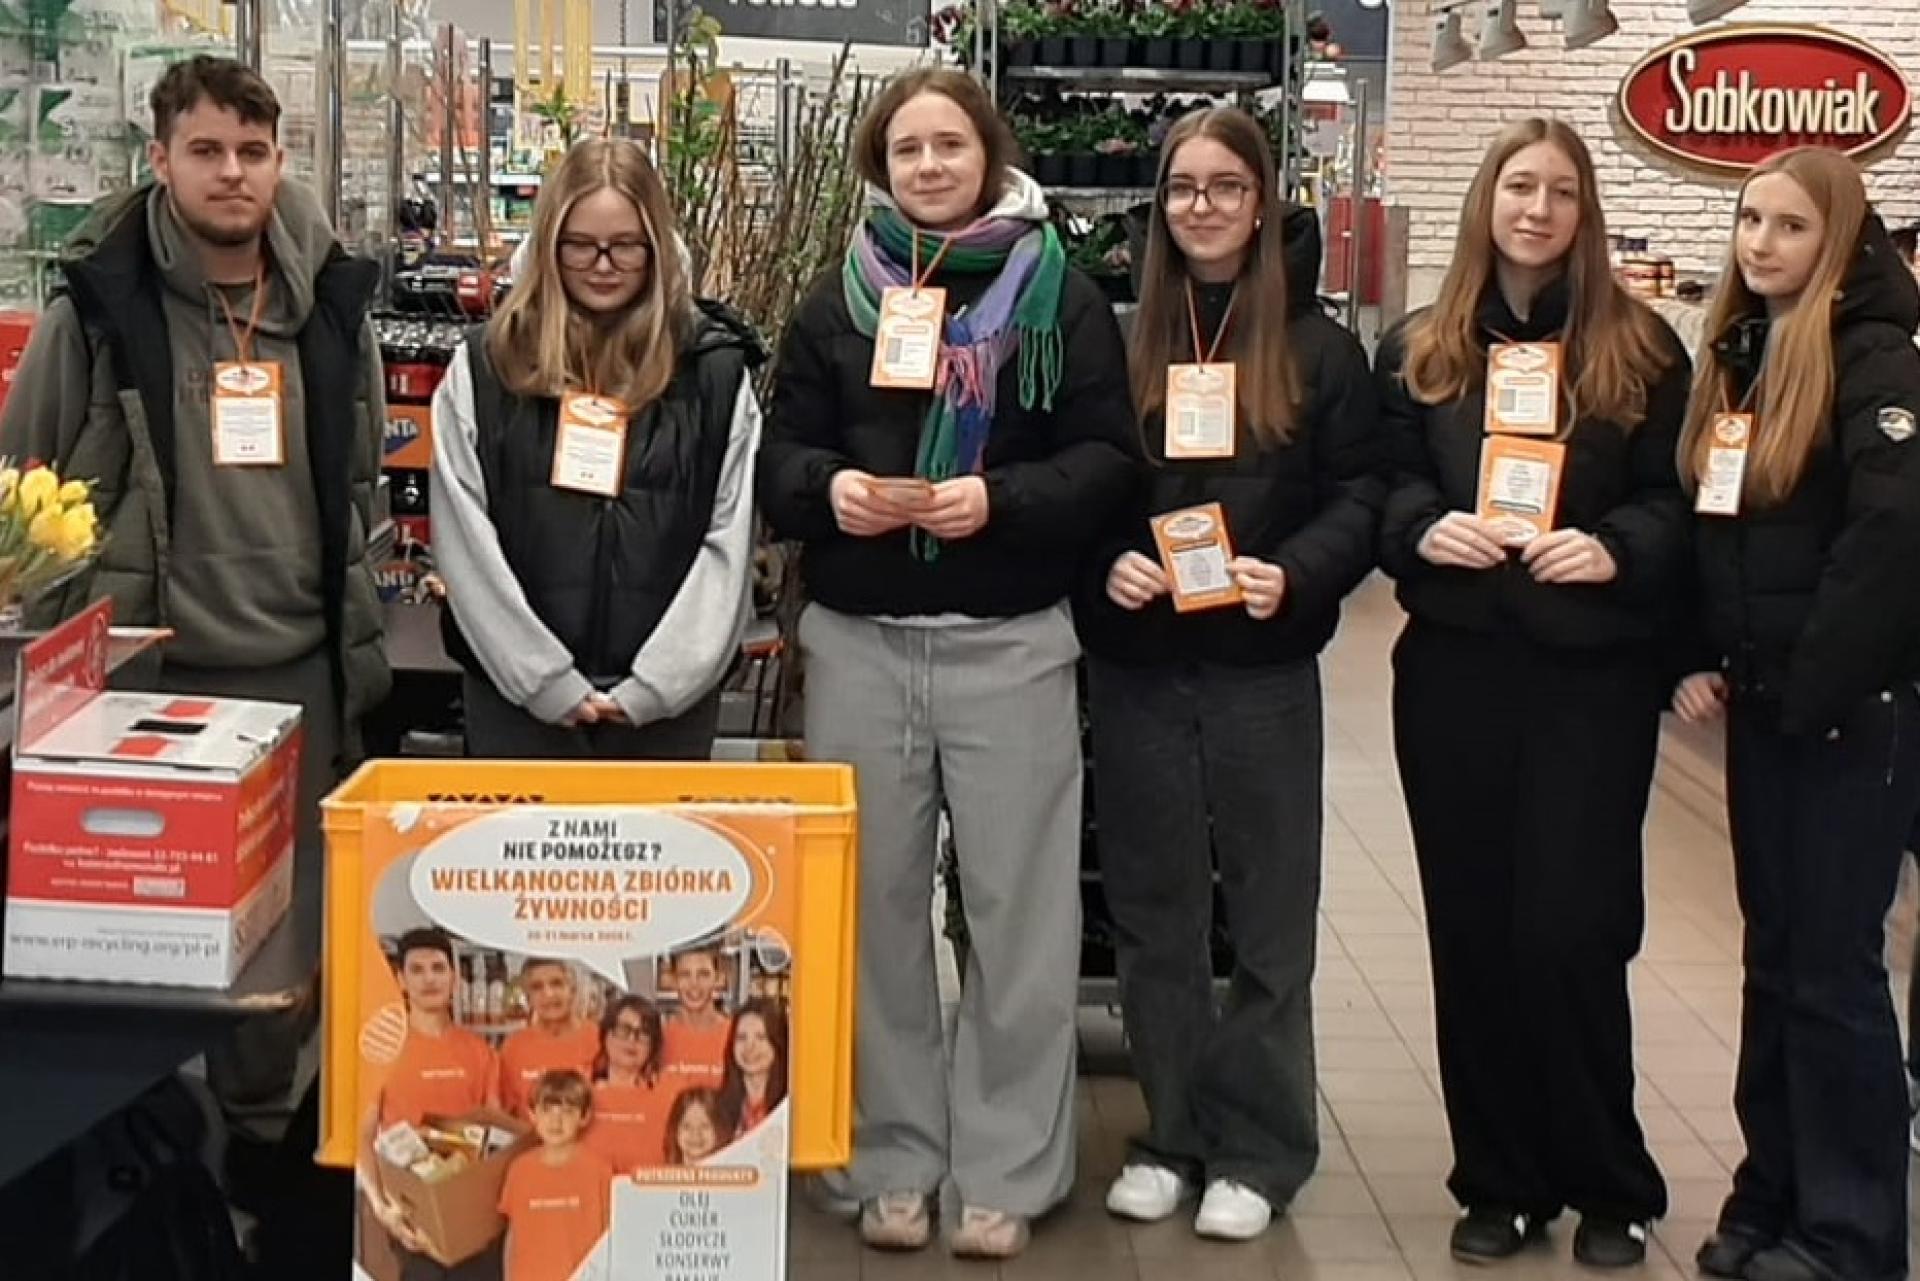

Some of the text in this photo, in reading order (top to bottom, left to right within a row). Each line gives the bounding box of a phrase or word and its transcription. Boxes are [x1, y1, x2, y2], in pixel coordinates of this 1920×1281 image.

[1665, 48, 1880, 134] Sobkowiak
[548, 820, 617, 838] Z NAMI
[504, 842, 538, 861] NIE
[431, 865, 733, 893] WIELKANOCNA ZBIÓRKA
[514, 896, 650, 921] ŻYWNOŚCI
[669, 1210, 718, 1228] CUKIER
[660, 1231, 726, 1248] SŁODYCZE
[656, 1252, 730, 1270] KONSERWY
